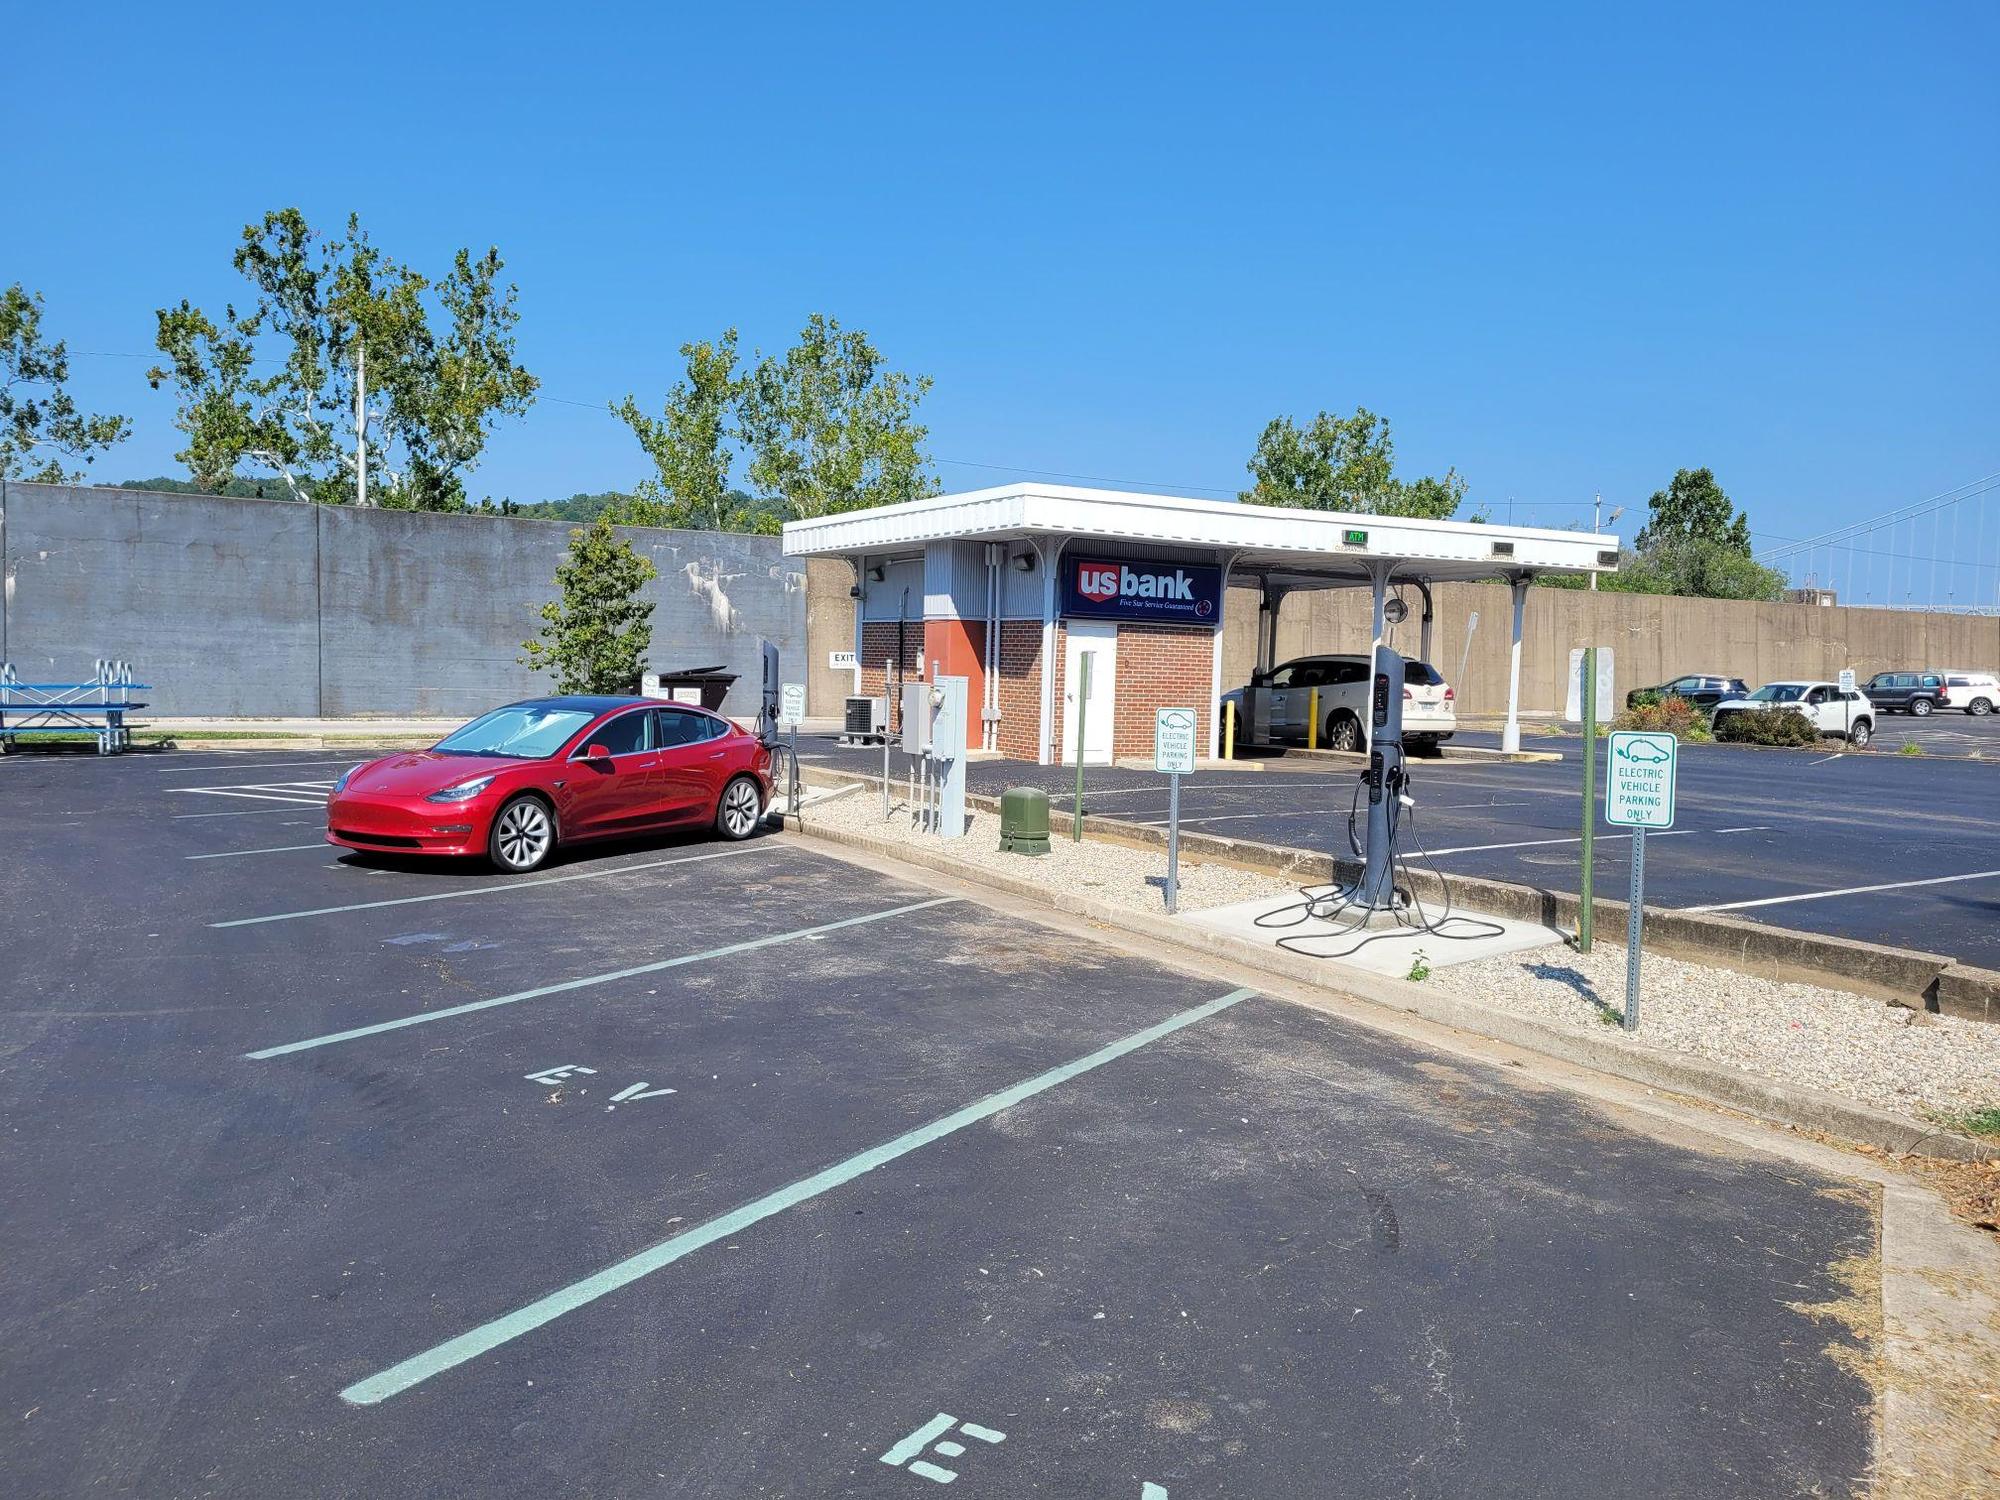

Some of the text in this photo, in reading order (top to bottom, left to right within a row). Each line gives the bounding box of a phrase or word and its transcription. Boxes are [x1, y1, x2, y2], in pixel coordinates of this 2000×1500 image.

[1349, 531, 1364, 542] ATM
[1119, 598, 1132, 607] Five
[1132, 599, 1144, 608] Star
[1144, 600, 1164, 609] Service
[834, 653, 855, 662] EXIT
[1162, 732, 1189, 740] ELECTRIC
[1163, 742, 1187, 750] VEHICLE
[1162, 751, 1188, 760] PARKING
[1167, 761, 1183, 769] ONLY
[1619, 767, 1664, 779] ELECTRIC
[1620, 781, 1661, 793] VEHICLE
[1619, 795, 1661, 807] PARKING
[1626, 809, 1652, 820] ONLY
